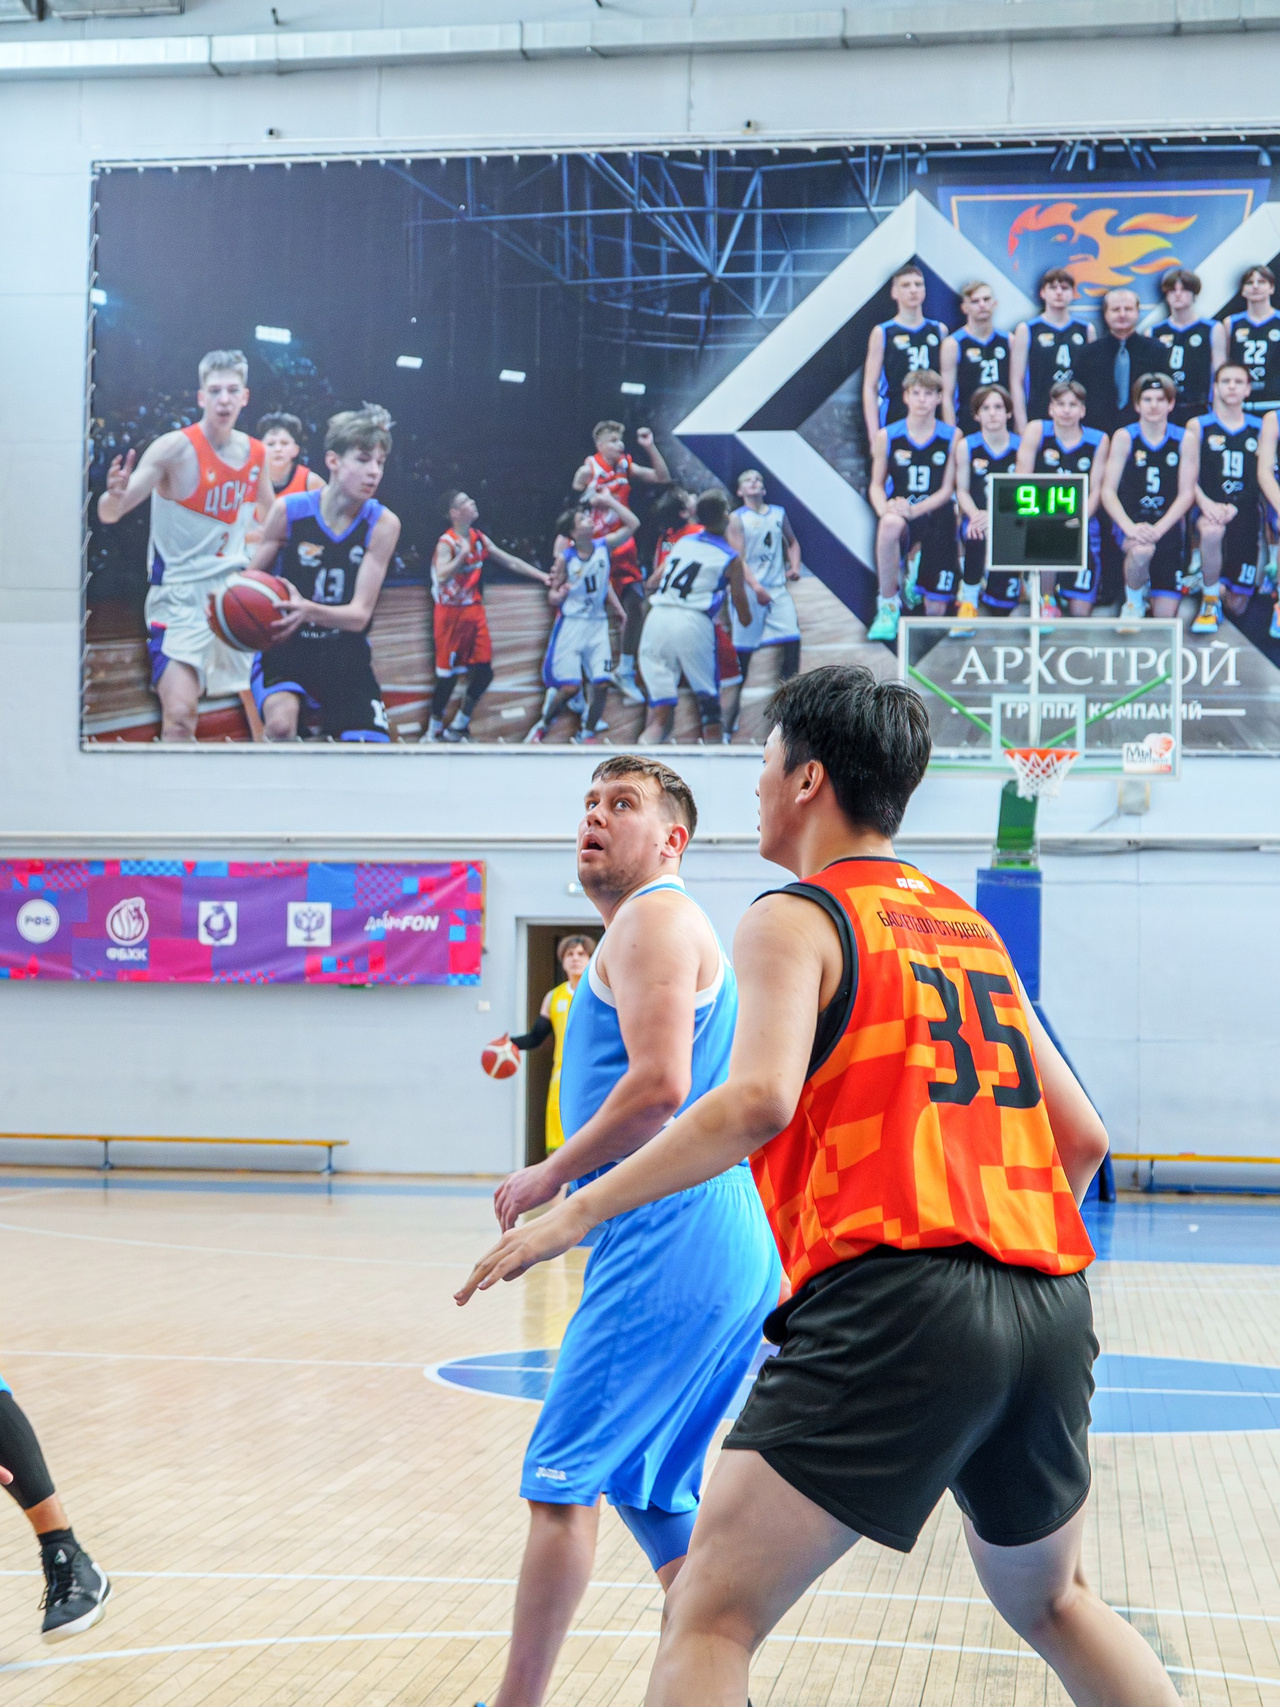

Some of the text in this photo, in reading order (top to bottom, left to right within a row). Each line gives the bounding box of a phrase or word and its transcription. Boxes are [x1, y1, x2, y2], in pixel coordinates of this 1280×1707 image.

[1221, 449, 1245, 478] 19
[907, 465, 931, 492] 13
[1146, 466, 1161, 494] 5
[951, 640, 1241, 687] АРХСТРОЙ
[909, 961, 1043, 1109] 35
